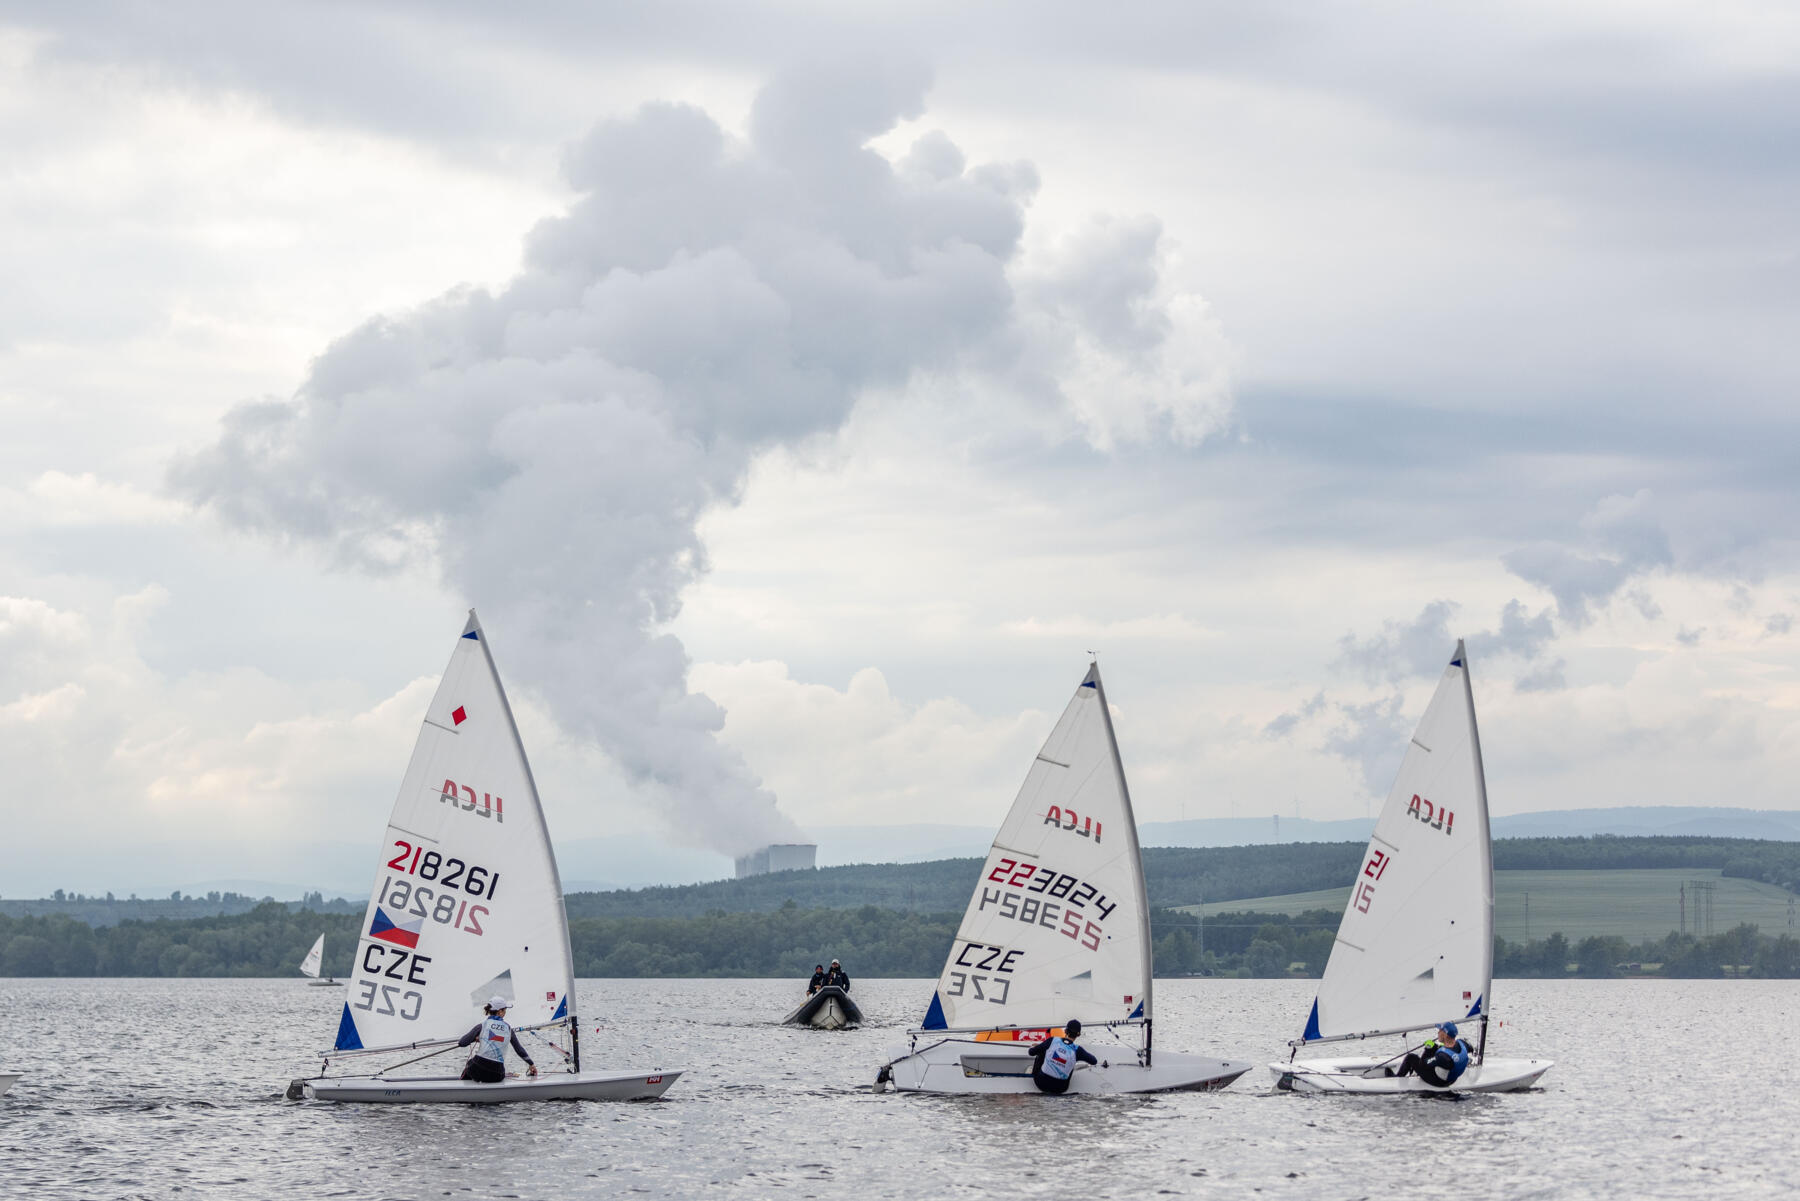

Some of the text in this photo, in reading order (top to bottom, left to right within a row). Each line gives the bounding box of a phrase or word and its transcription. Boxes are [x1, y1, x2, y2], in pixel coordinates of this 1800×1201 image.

[387, 840, 499, 900] 218261
[1365, 850, 1390, 881] 21
[989, 858, 1117, 921] 223824
[363, 944, 432, 986] CZE
[955, 942, 1024, 973] CZE
[490, 1022, 505, 1032] CZE
